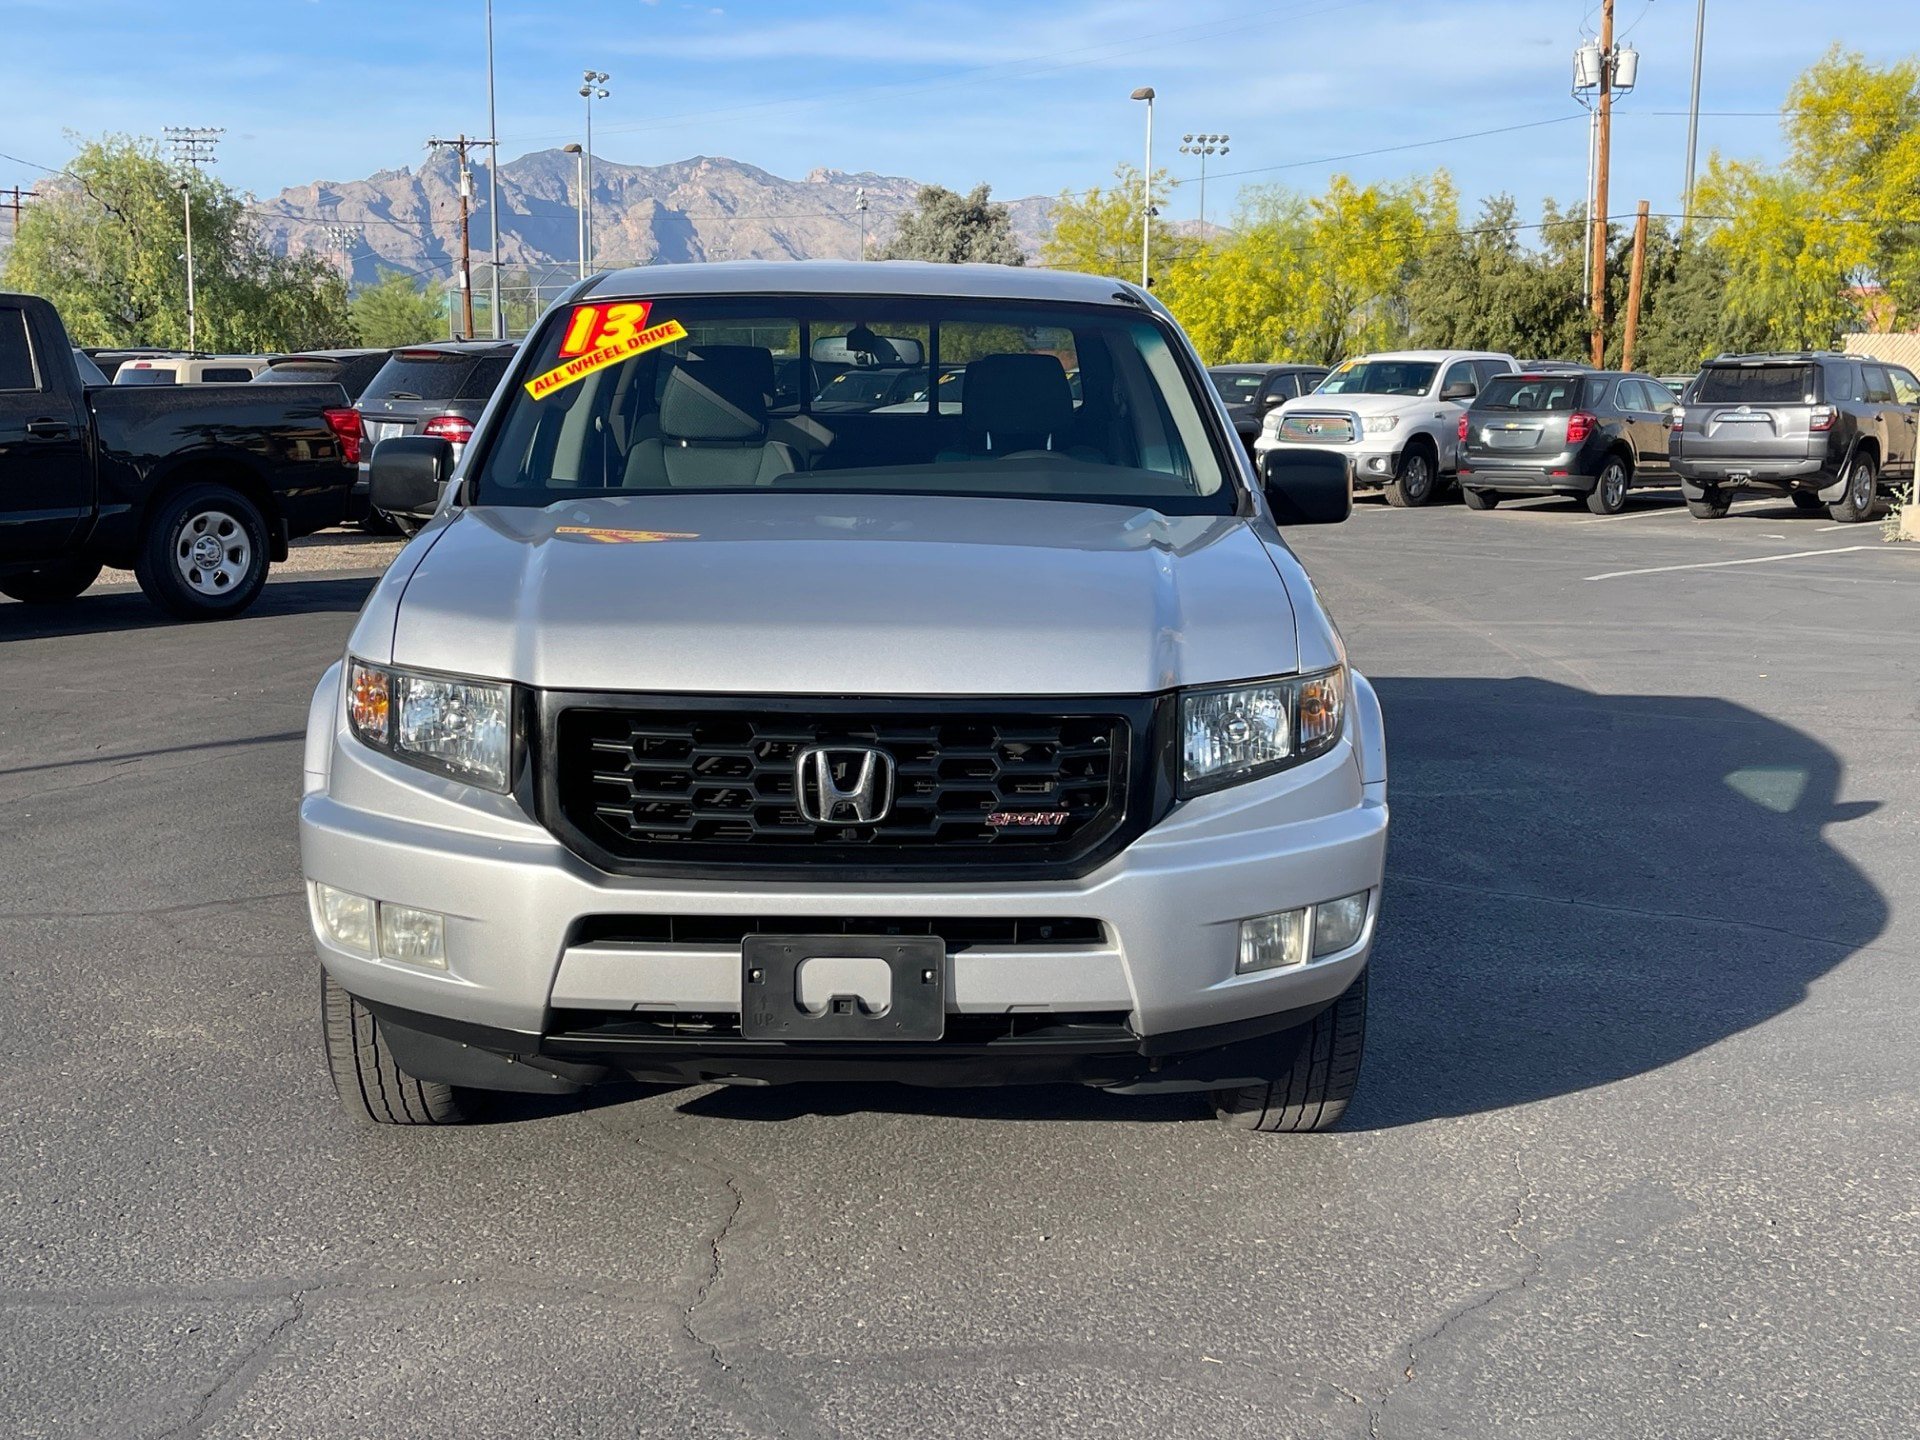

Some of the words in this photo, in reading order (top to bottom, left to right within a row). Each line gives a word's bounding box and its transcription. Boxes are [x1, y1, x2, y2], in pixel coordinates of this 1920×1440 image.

[563, 304, 645, 354] 13
[534, 371, 566, 394] ALL
[566, 345, 625, 376] WHEEL
[627, 322, 678, 351] DRIVE
[985, 812, 1070, 826] SPORT
[754, 1013, 775, 1026] UP
